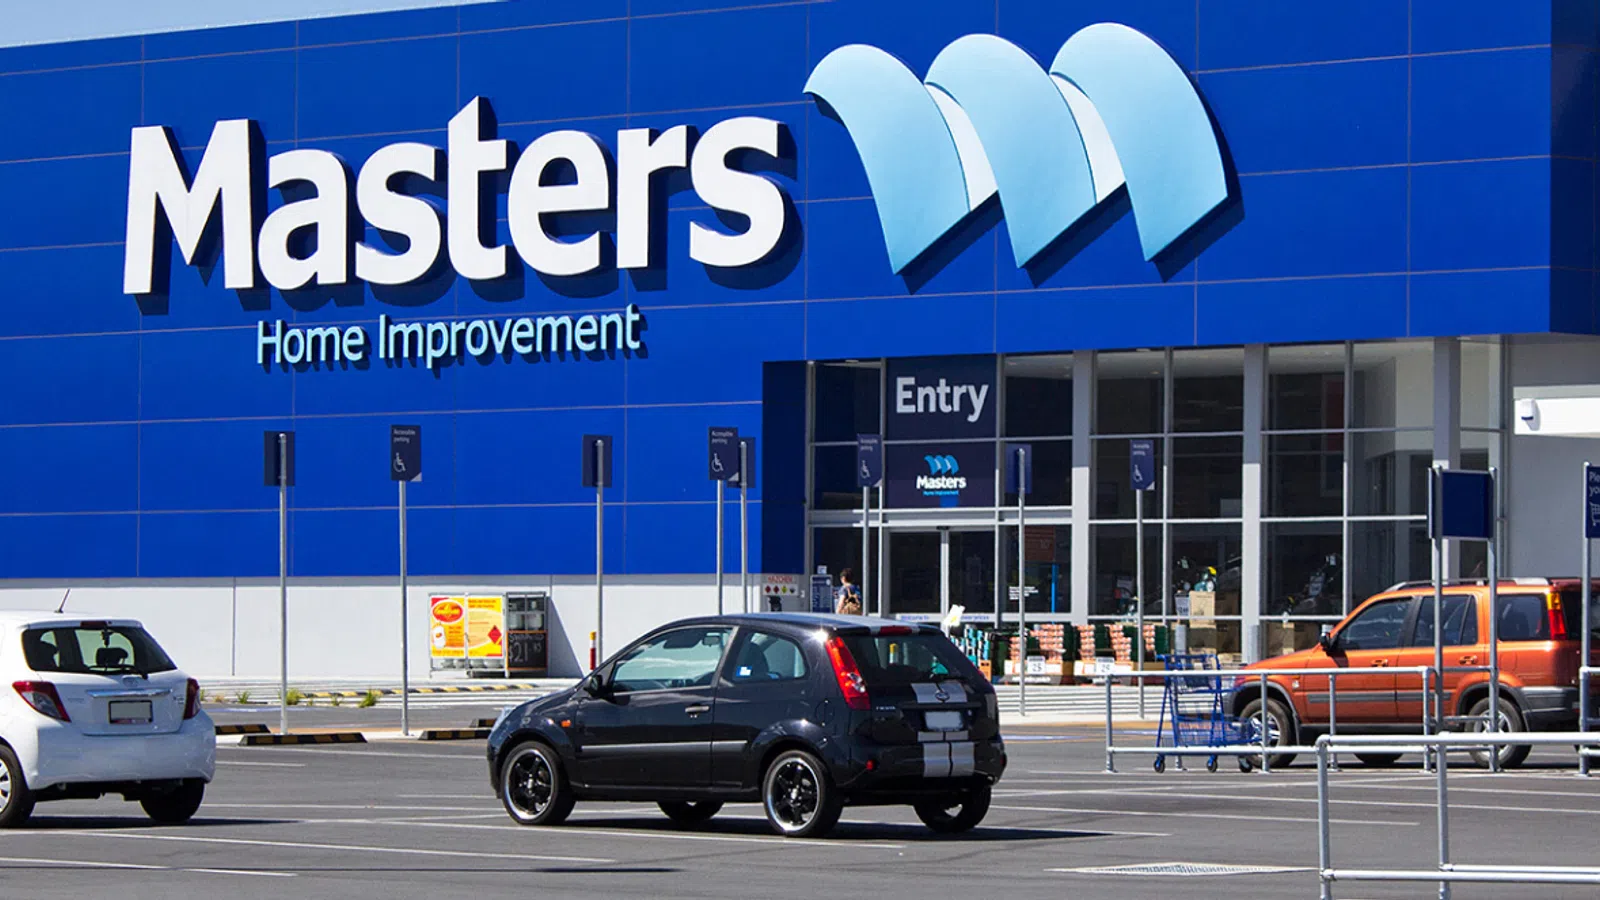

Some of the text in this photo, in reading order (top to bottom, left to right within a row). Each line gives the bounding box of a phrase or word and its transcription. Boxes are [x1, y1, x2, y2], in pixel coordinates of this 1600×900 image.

[123, 95, 786, 296] Masters
[256, 303, 642, 369] Home Improvement
[896, 376, 989, 422] Entry
[916, 475, 967, 490] Masters
